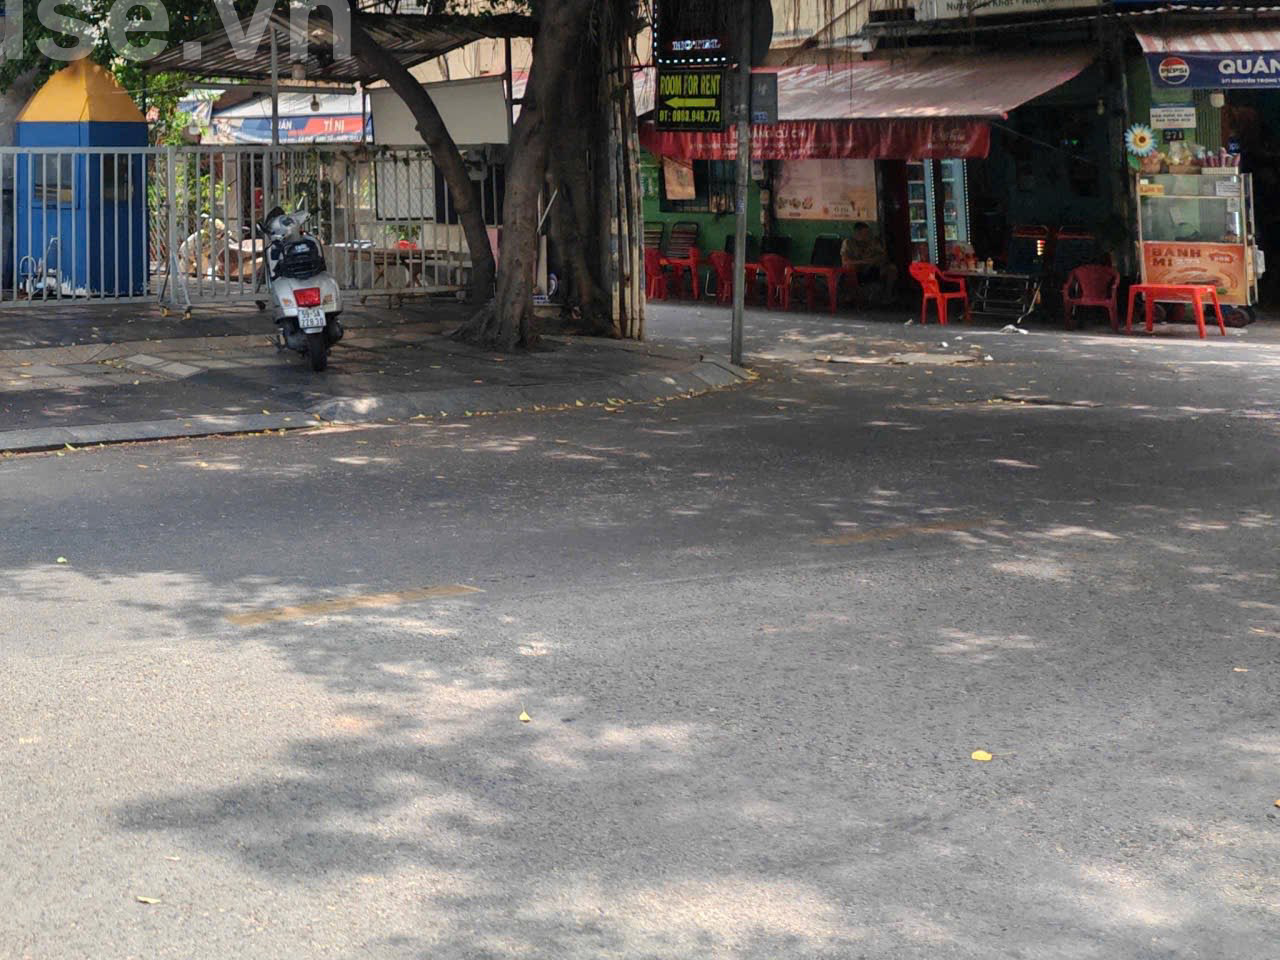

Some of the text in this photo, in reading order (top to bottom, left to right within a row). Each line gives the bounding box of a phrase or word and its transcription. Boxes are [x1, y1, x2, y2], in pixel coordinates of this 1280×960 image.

[659, 74, 721, 96] ROOM FOR RENT
